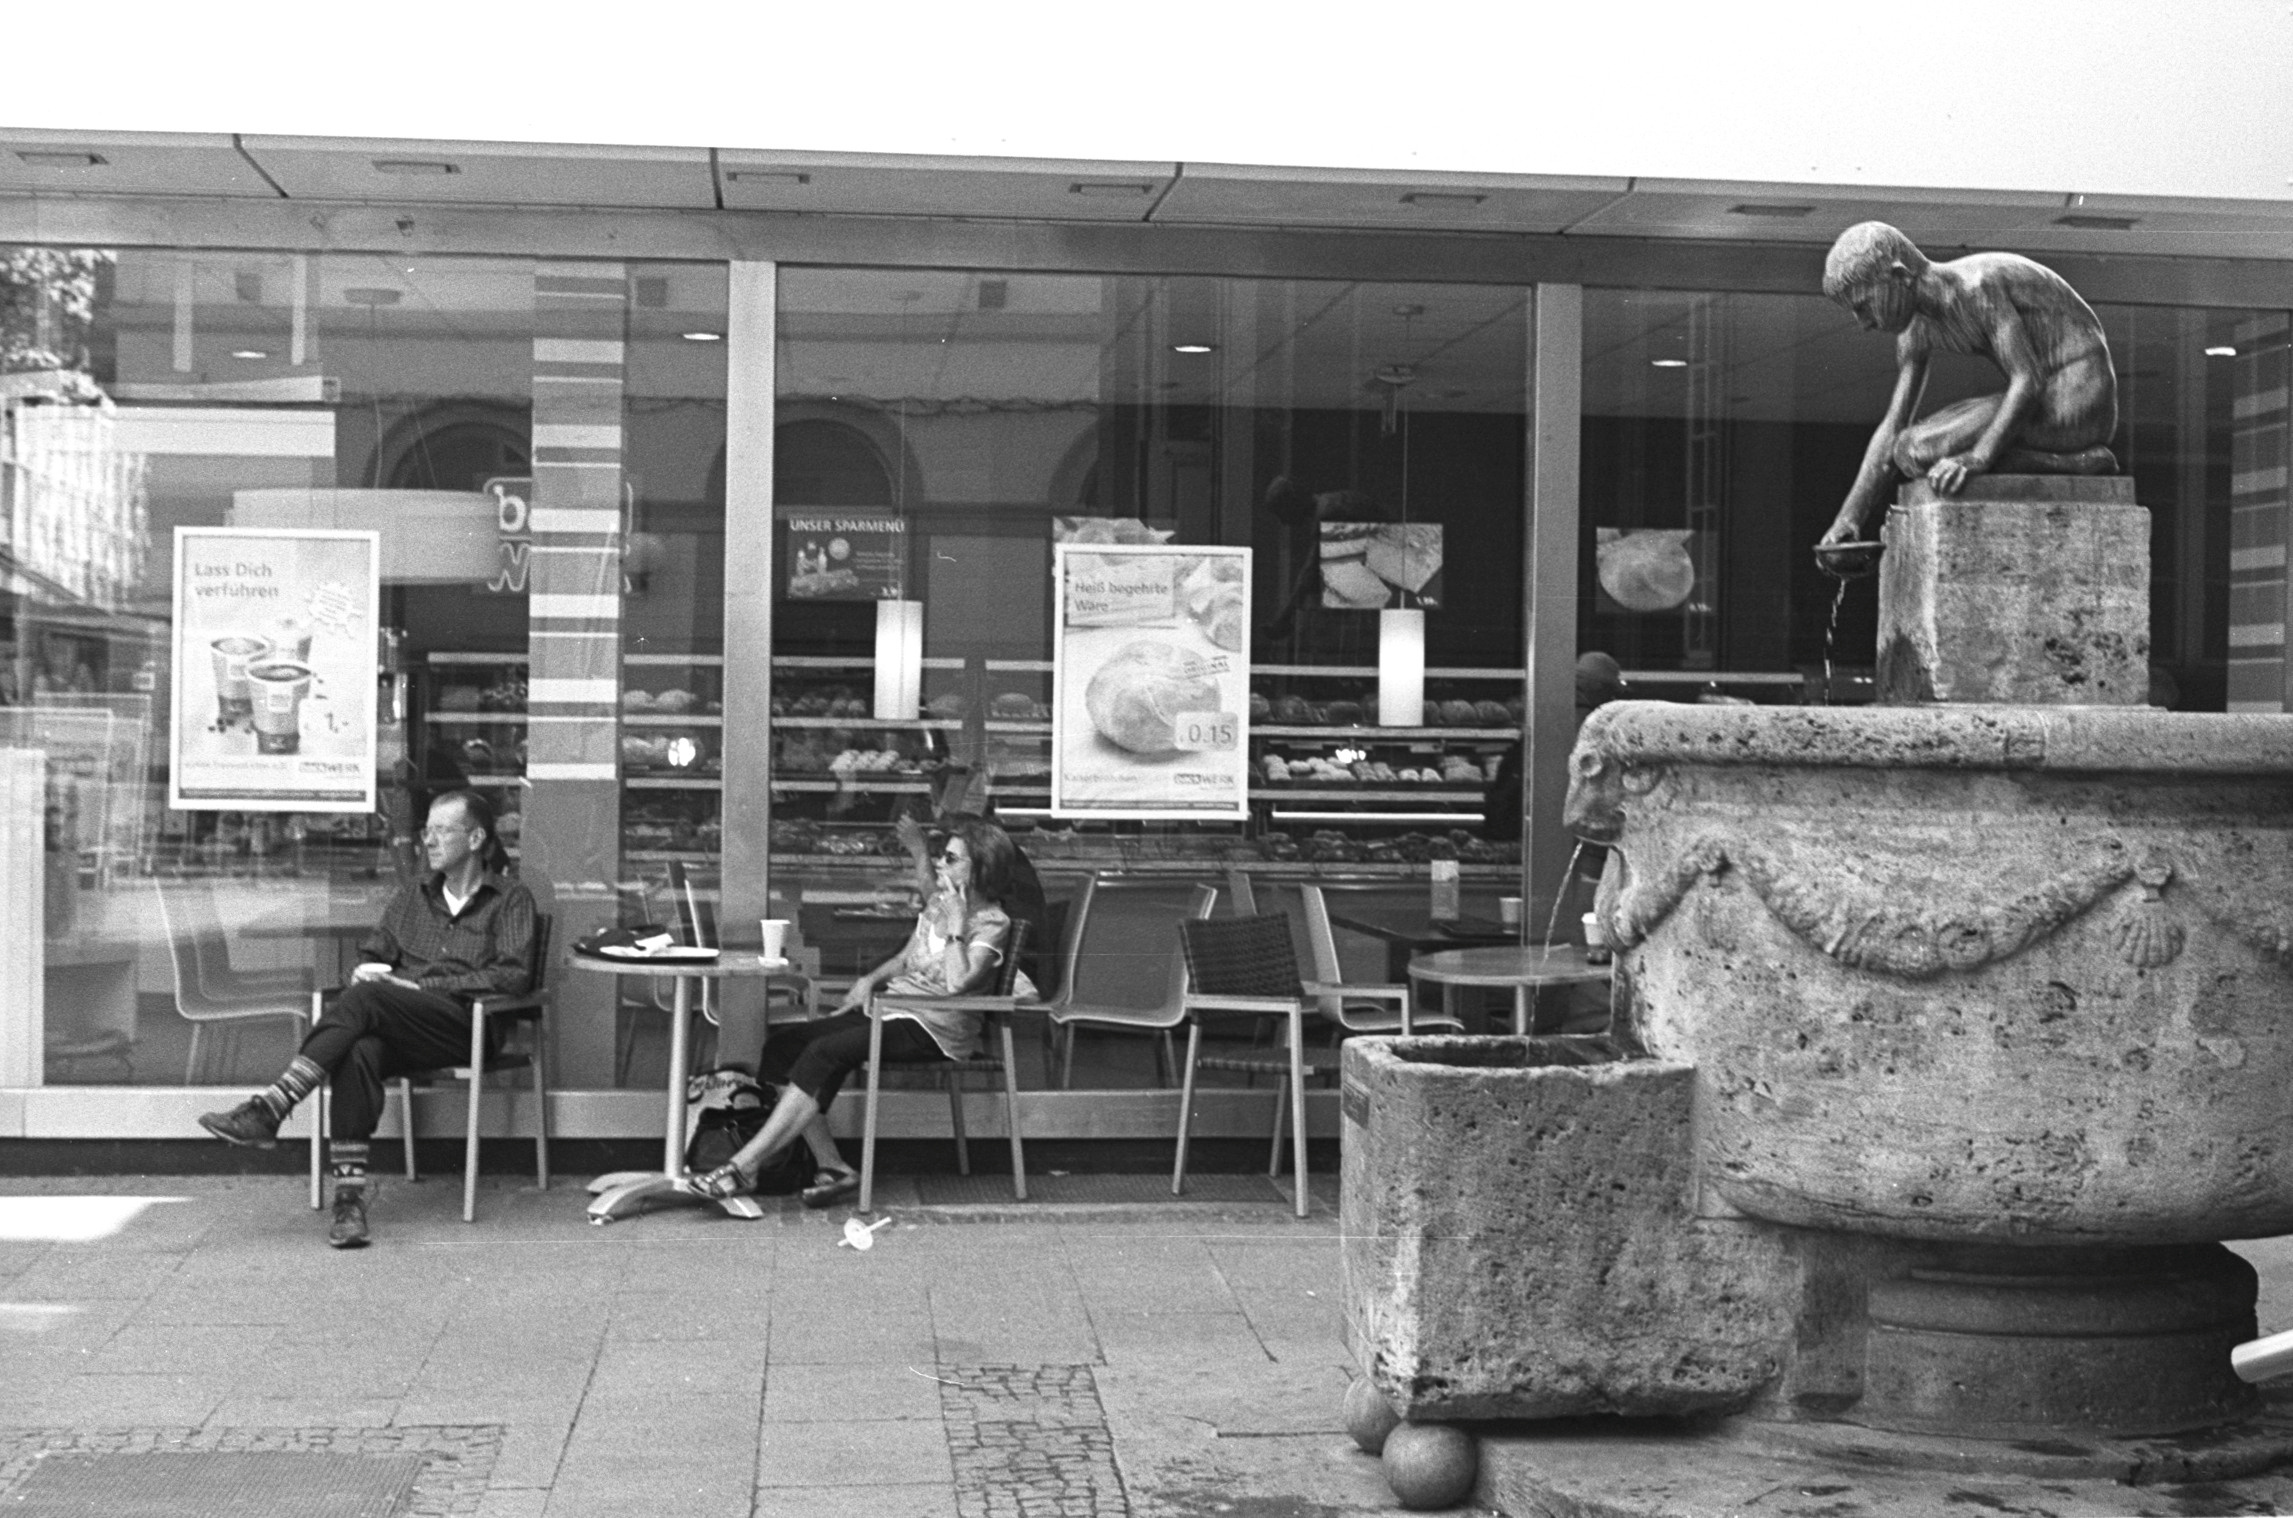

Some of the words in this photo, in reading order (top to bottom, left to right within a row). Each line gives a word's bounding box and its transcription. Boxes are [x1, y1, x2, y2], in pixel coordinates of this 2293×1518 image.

[789, 519, 832, 532] UNSER
[194, 562, 230, 577] Lass
[235, 561, 273, 578] Dich
[1075, 581, 1106, 594] Heiß
[1108, 581, 1169, 598] begehrte
[1074, 600, 1110, 613] Ware
[1188, 723, 1233, 744] 0.15
